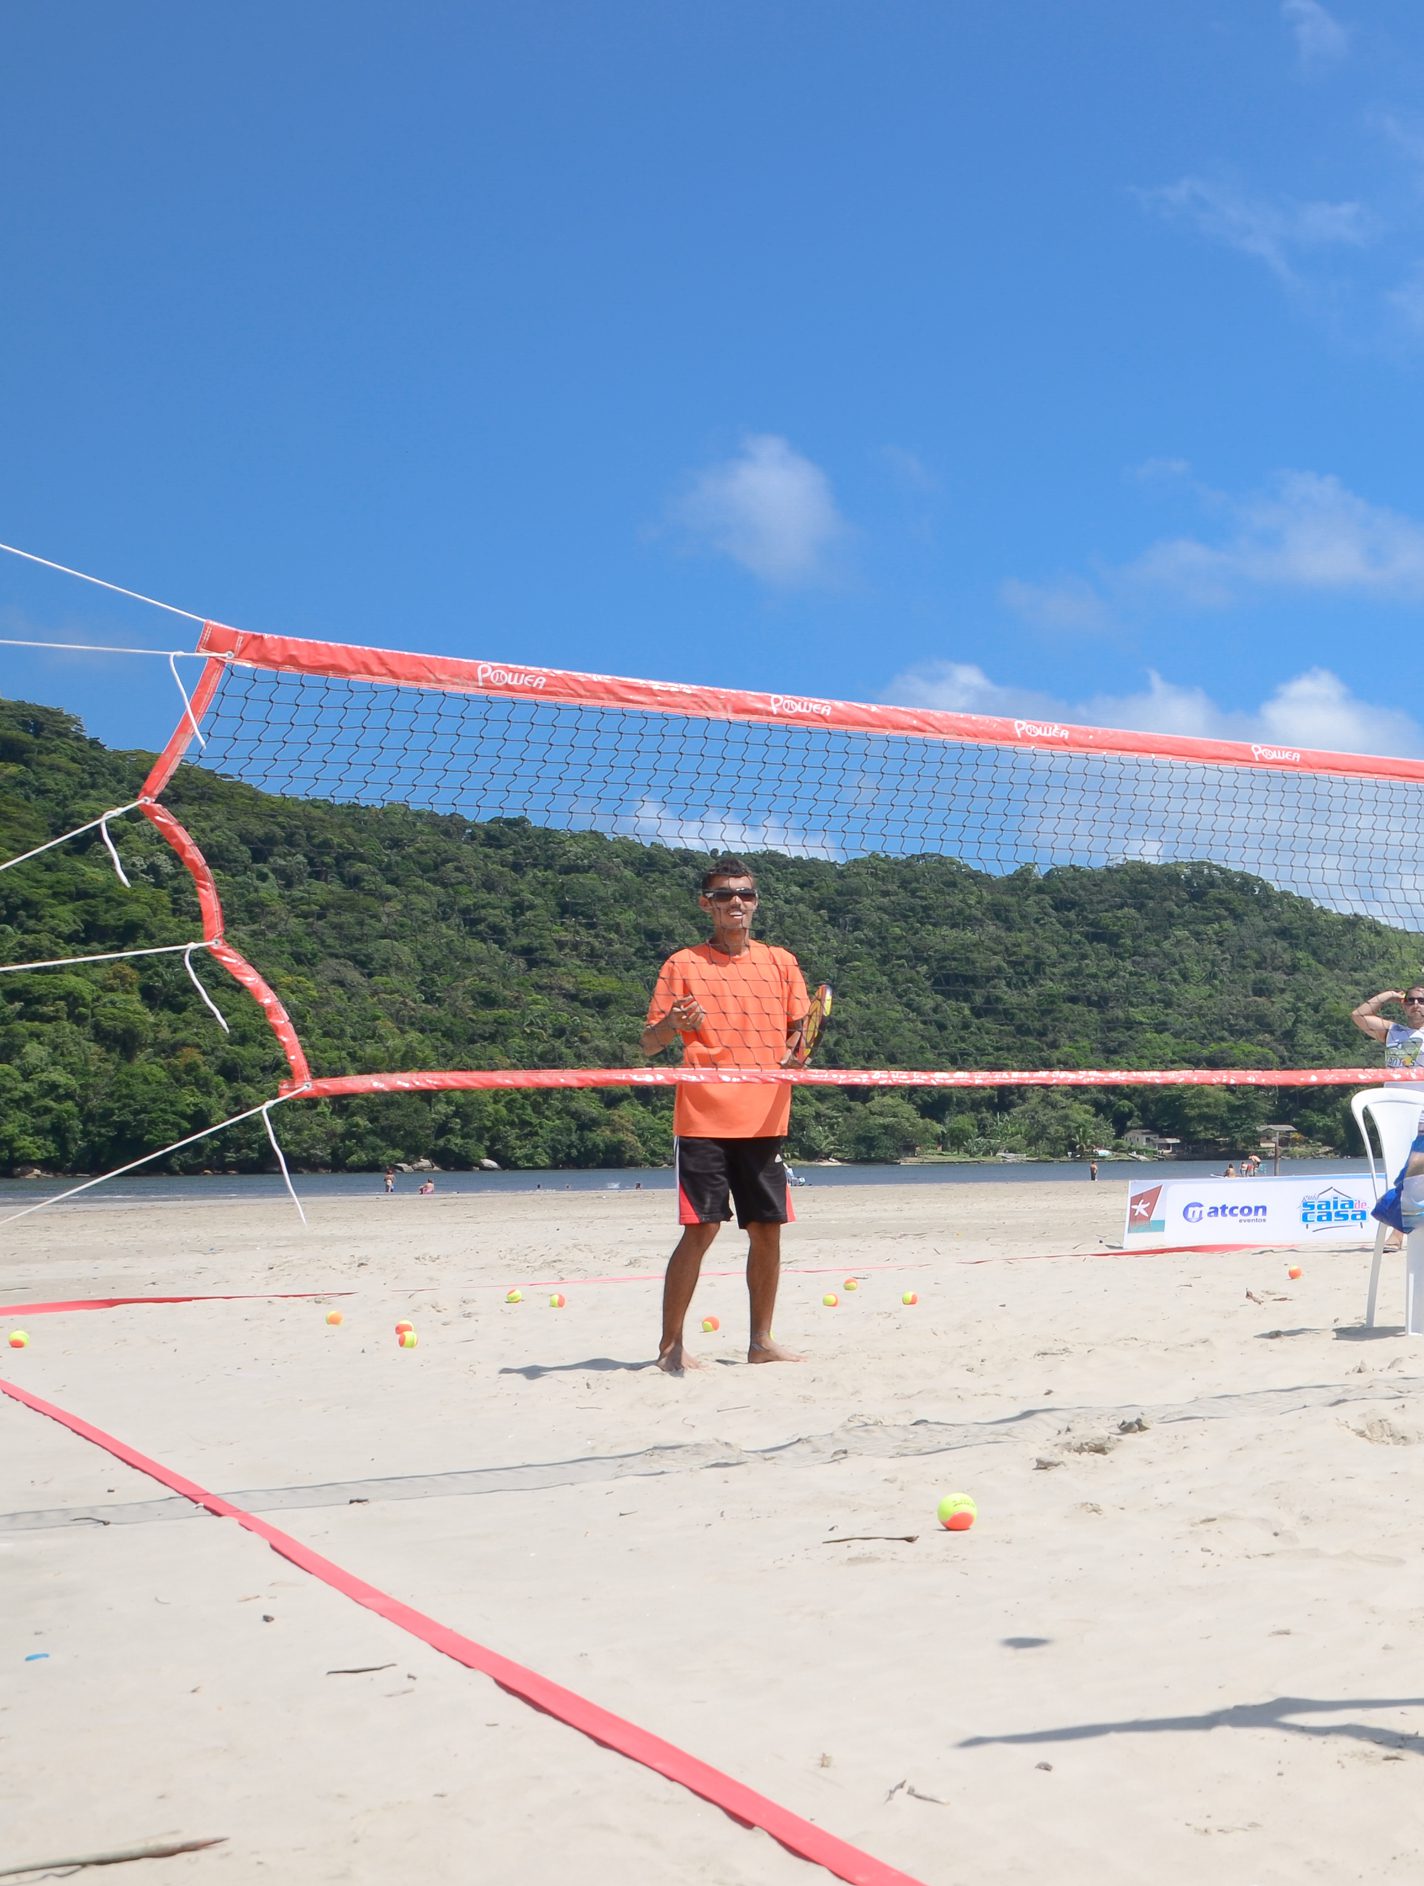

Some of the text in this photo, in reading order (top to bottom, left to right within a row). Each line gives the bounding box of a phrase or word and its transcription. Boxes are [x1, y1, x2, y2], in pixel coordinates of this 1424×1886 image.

[477, 663, 547, 689] POWER
[771, 694, 832, 716] POWER
[1014, 719, 1069, 739] POWER
[1251, 744, 1301, 762] POWER
[1355, 1200, 1367, 1209] de
[1302, 1210, 1367, 1222] casa
